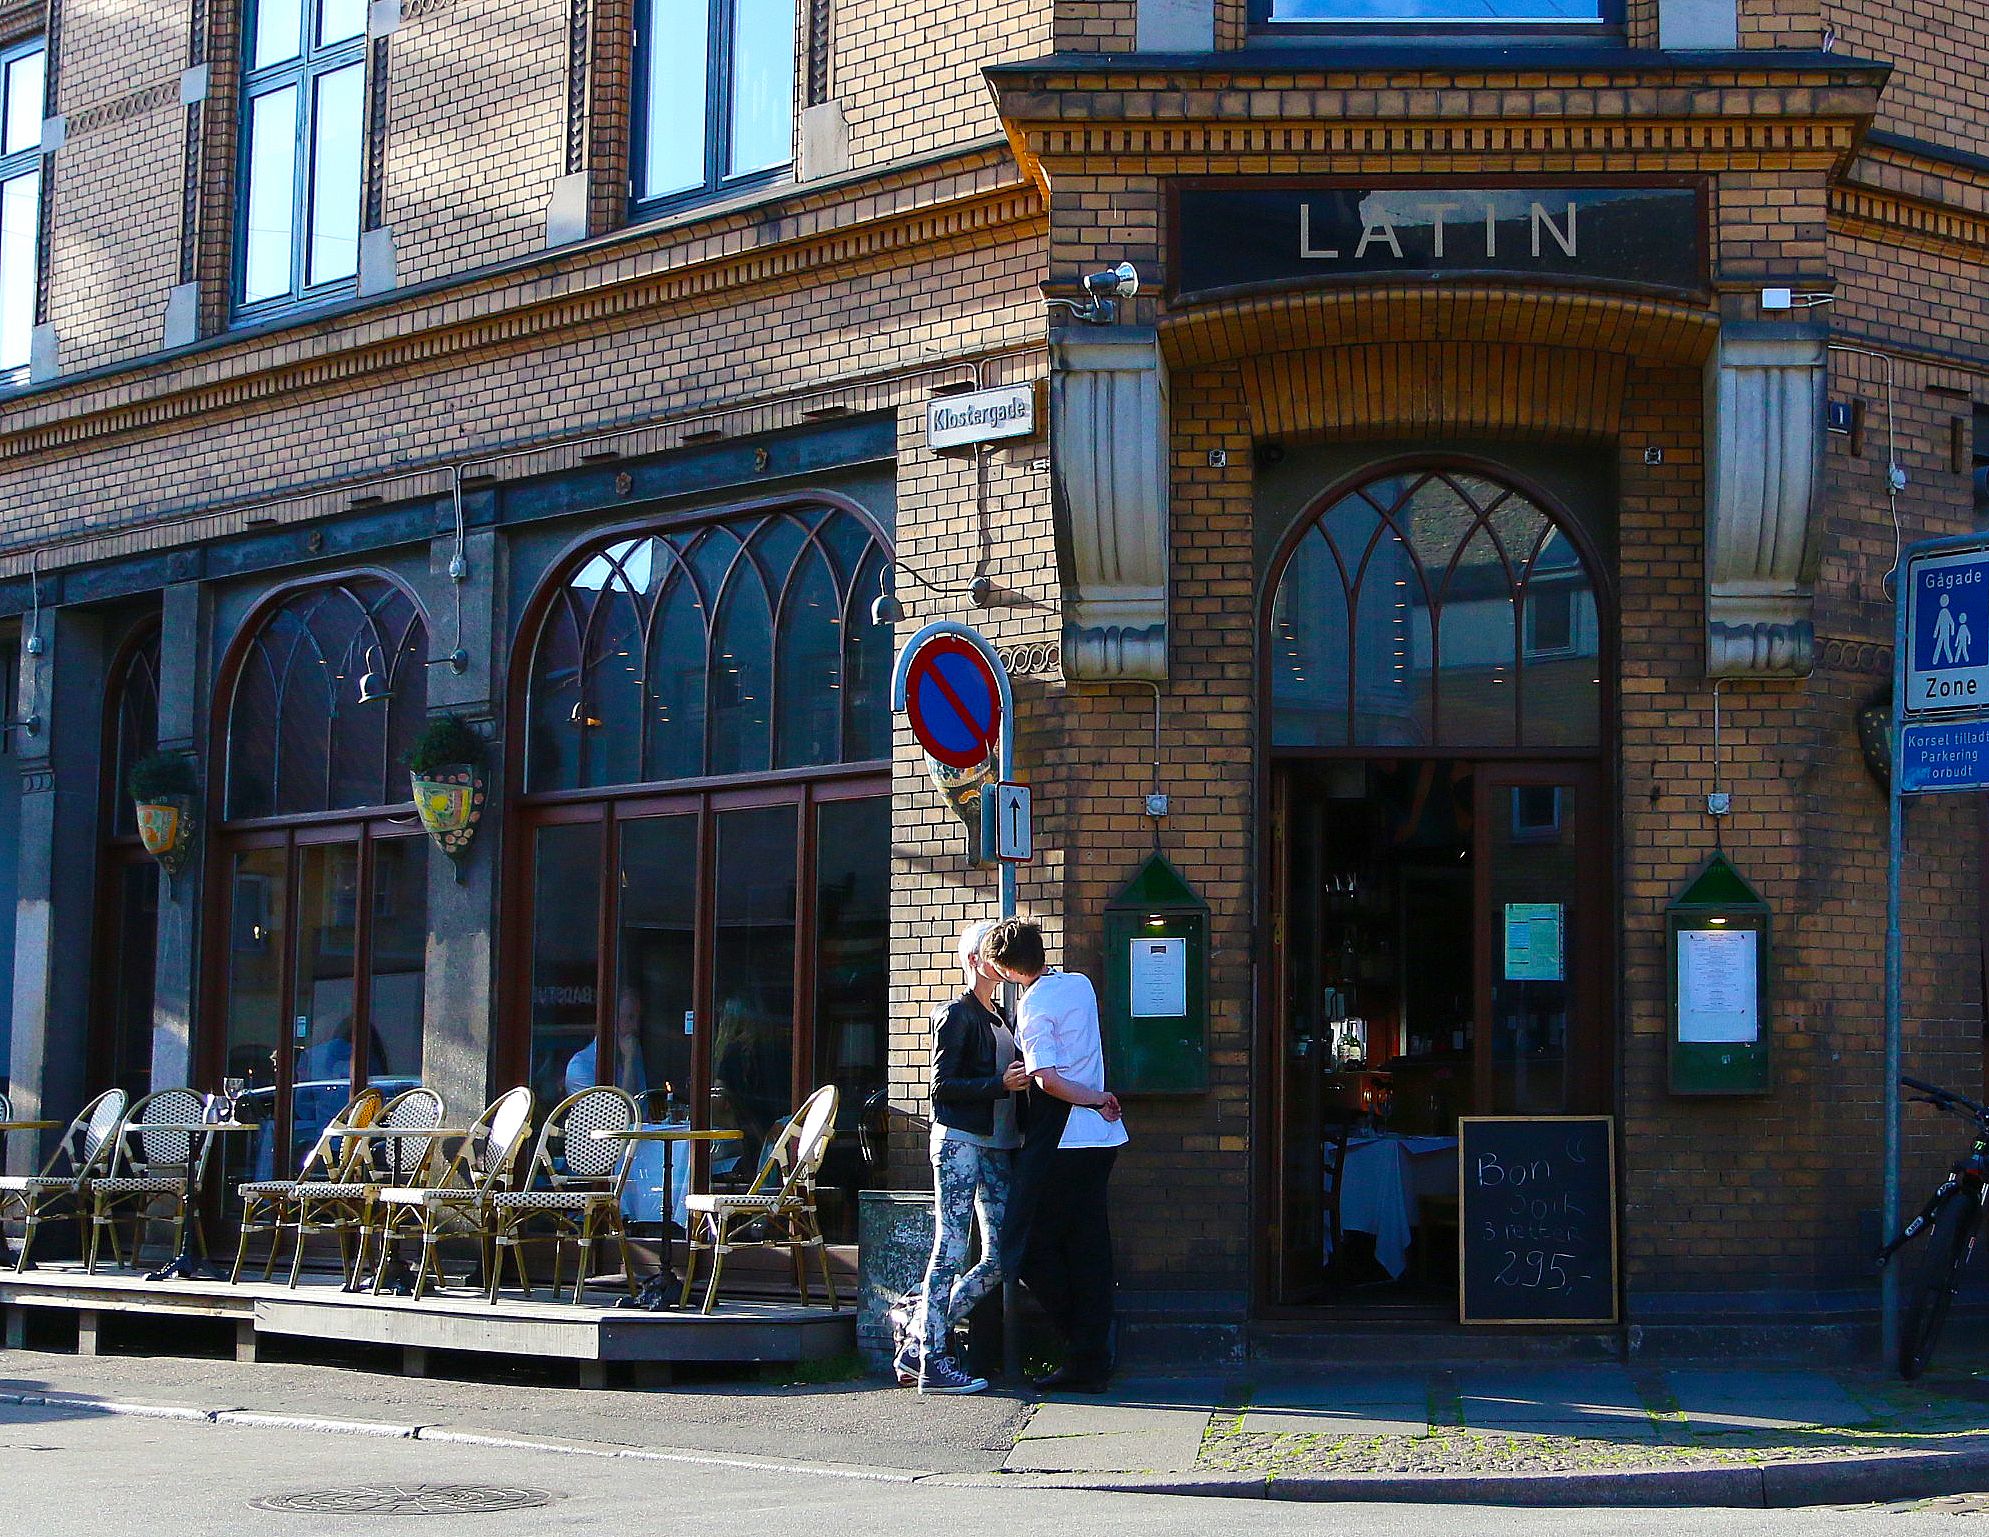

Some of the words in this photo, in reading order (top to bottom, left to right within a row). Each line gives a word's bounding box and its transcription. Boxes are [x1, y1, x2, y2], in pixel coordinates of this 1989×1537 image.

[1300, 202, 1577, 258] LATIN
[934, 397, 1026, 432] Klostergade
[1925, 569, 1983, 590] Gågade
[1926, 677, 1977, 699] Zone
[1921, 749, 1978, 763] Parkering
[1478, 1152, 1551, 1186] Bon
[1483, 1221, 1497, 1241] 3
